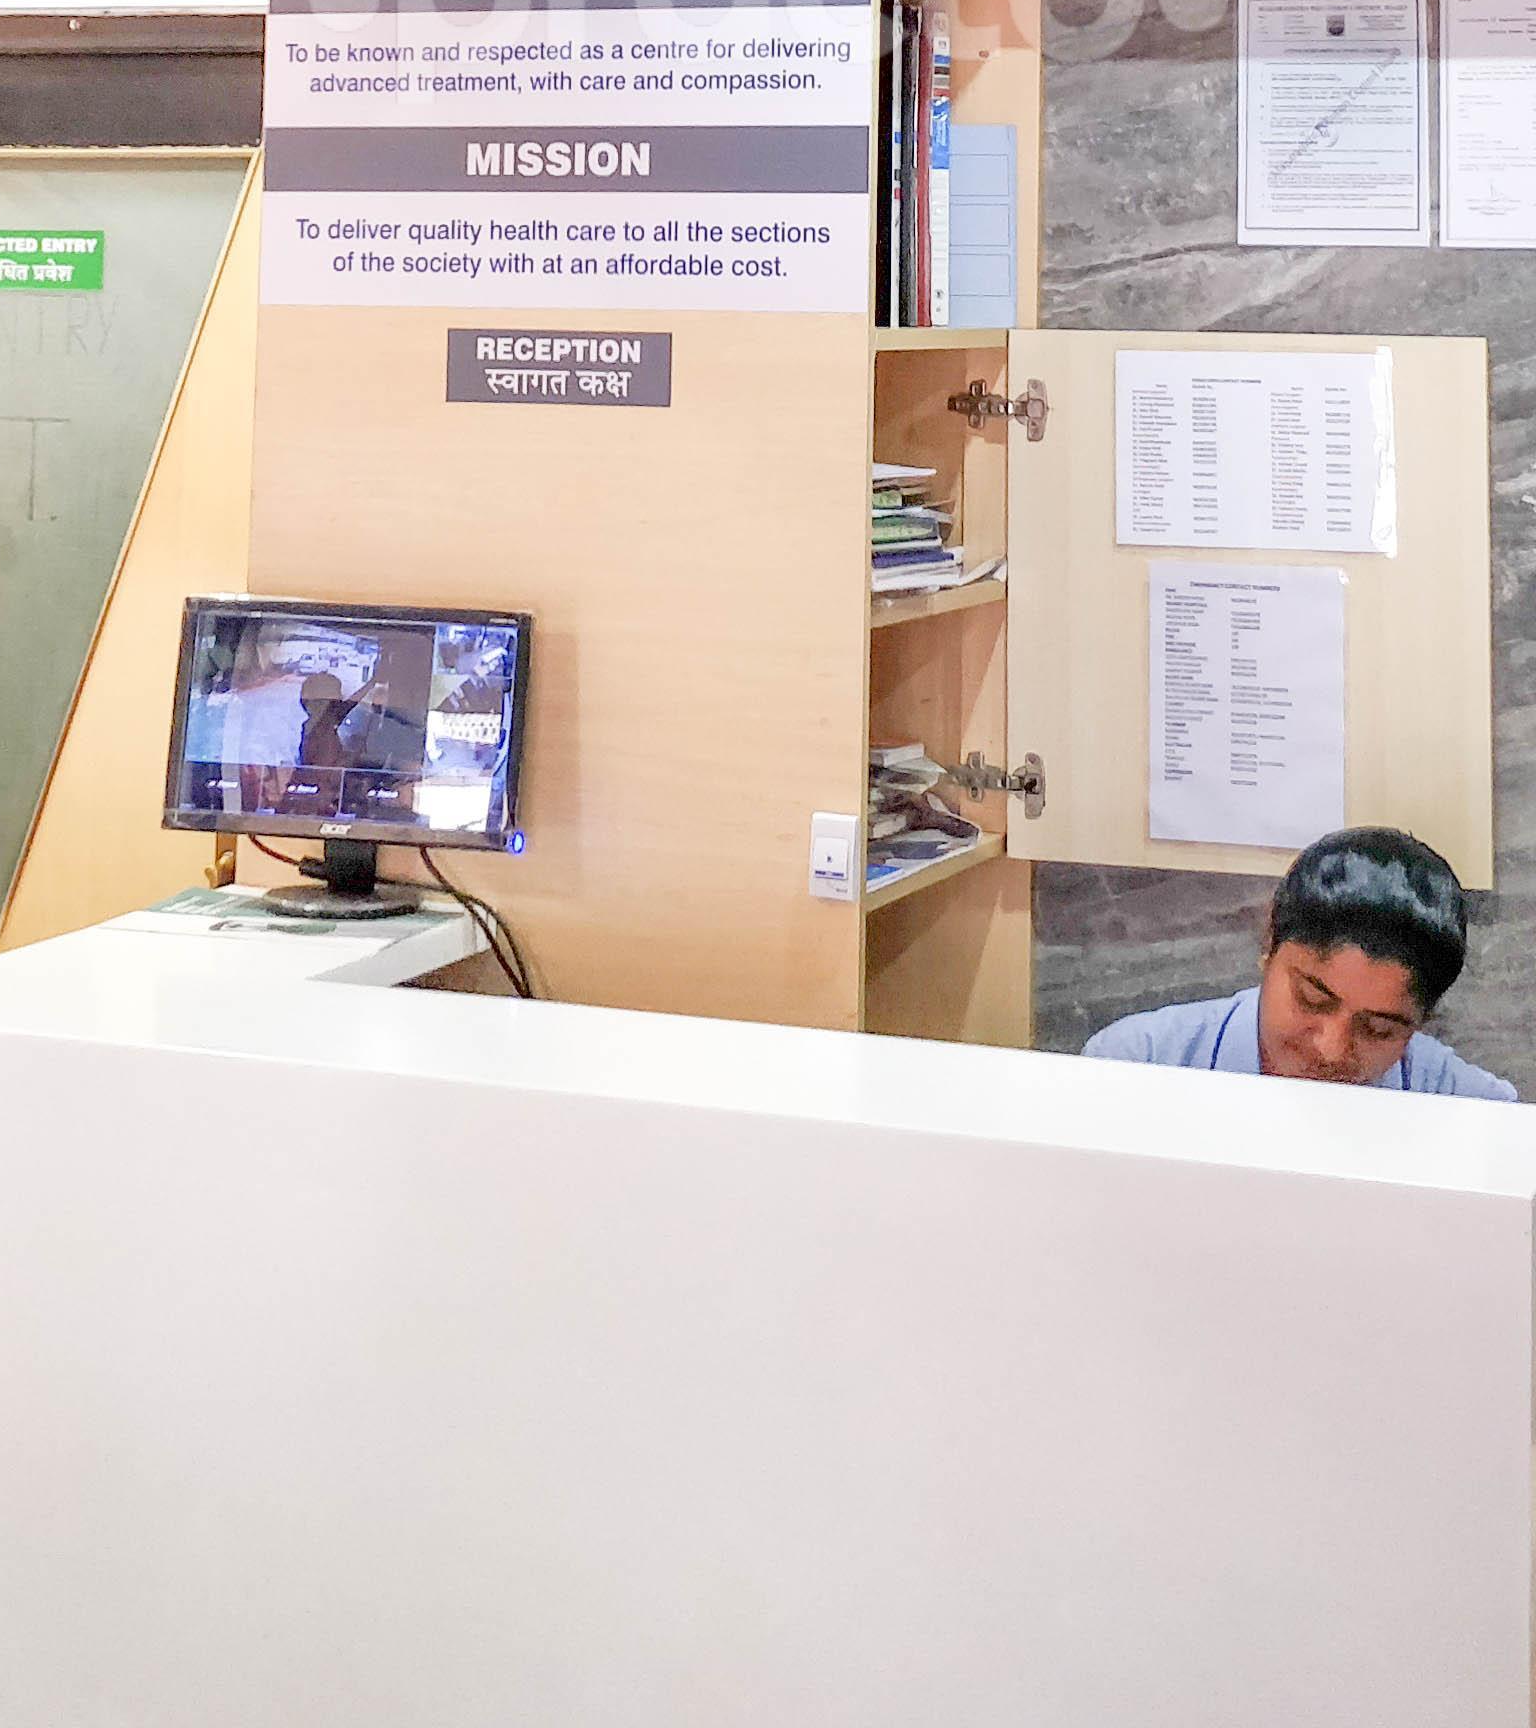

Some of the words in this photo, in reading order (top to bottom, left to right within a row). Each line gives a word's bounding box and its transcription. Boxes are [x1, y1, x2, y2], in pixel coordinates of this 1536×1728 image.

[285, 43, 308, 63] To
[315, 43, 340, 63] be
[347, 43, 414, 62] known
[421, 42, 460, 62] and
[468, 40, 572, 65] respected
[579, 44, 604, 60] as
[611, 45, 624, 60] a
[631, 41, 699, 60] centre
[706, 39, 736, 59] for
[742, 37, 851, 64] delivering
[310, 73, 410, 92] advanced
[417, 72, 522, 94] treatment,
[529, 71, 572, 91] with
[579, 75, 626, 91] care
[633, 70, 673, 90] and
[681, 69, 822, 95] compassion.
[466, 142, 651, 177] MISSION
[41, 237, 98, 254] ENTRY
[296, 218, 320, 240] To
[328, 219, 401, 240] deliver
[408, 219, 482, 246] quality
[490, 219, 558, 241] health
[566, 224, 616, 242] care
[624, 222, 645, 242] to
[653, 220, 679, 242] all
[687, 220, 723, 243] the
[731, 221, 830, 244] sections
[333, 251, 355, 272] of
[360, 252, 395, 272] the
[402, 252, 482, 279] society
[489, 252, 534, 274] with
[542, 254, 563, 274] at
[570, 258, 598, 274] an
[605, 253, 723, 276] affordable
[731, 256, 788, 277] cost.
[476, 336, 641, 364] RECEPTION
[484, 368, 571, 396] स्वागत
[575, 370, 632, 398] कक्ष
